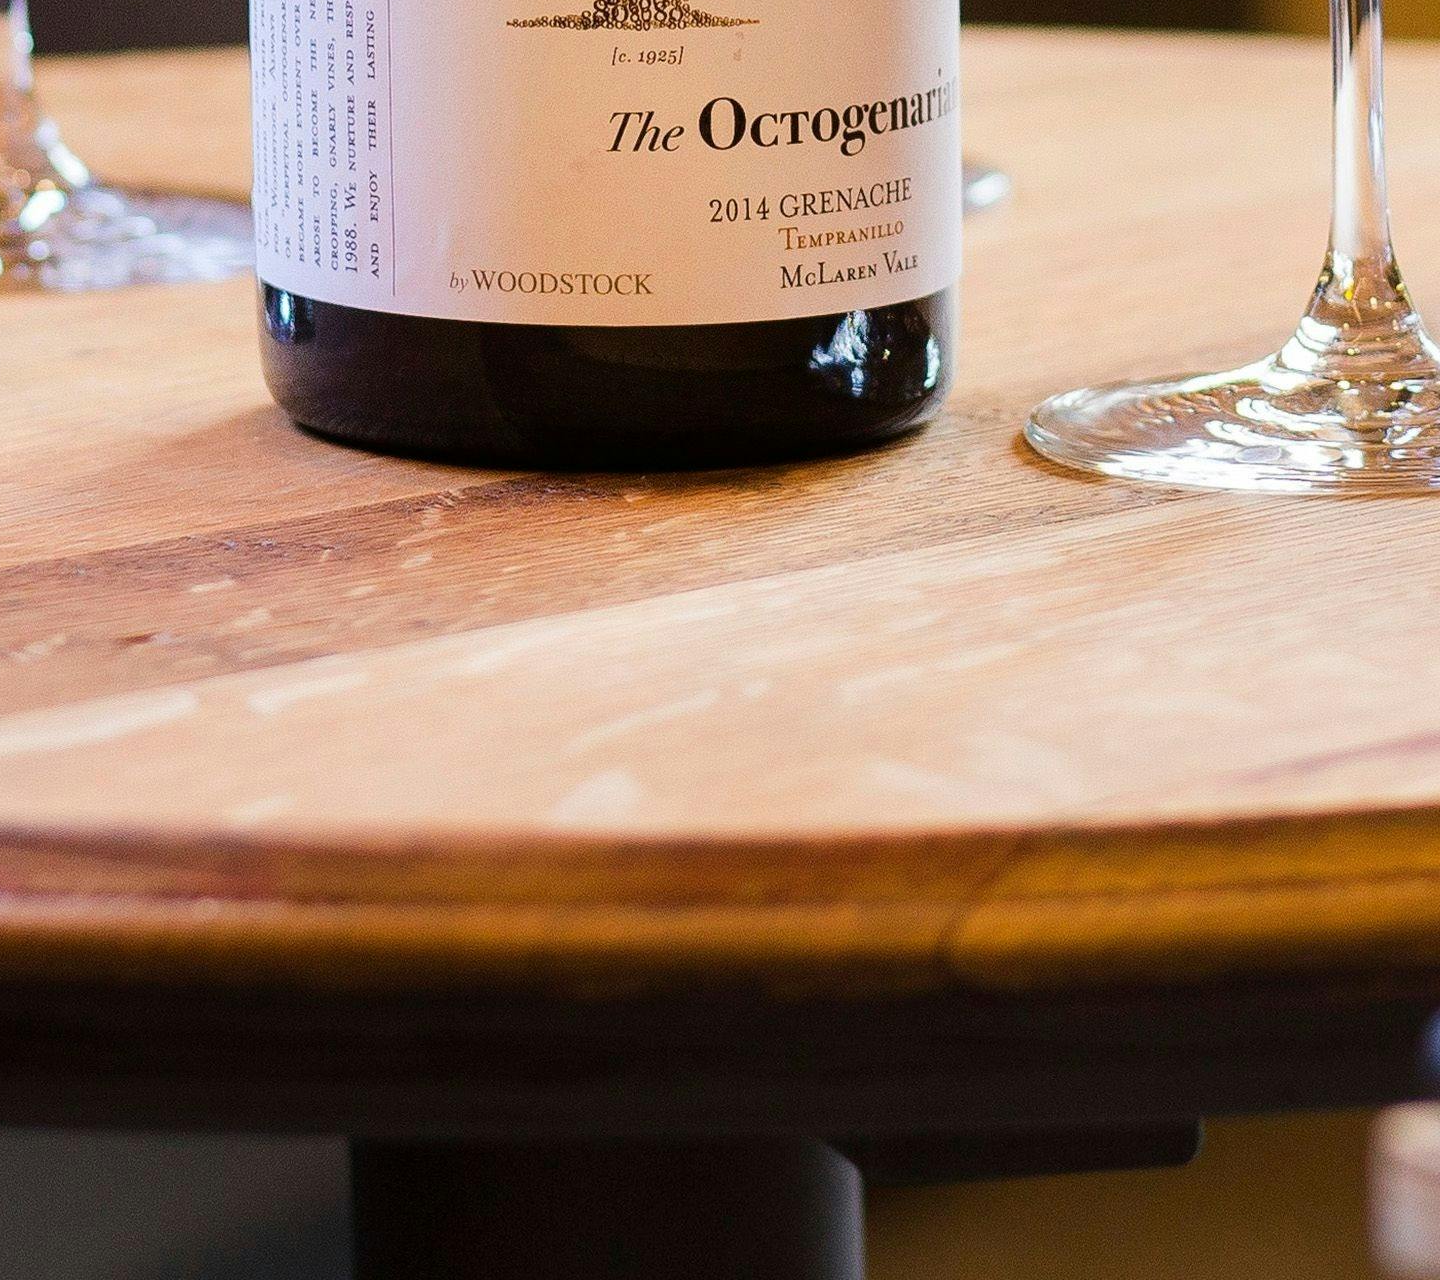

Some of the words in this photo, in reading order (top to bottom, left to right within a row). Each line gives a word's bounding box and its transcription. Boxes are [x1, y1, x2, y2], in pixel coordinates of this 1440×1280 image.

[327, 38, 336, 91] VINES,
[346, 50, 354, 86] AND
[366, 10, 375, 80] LASTING
[638, 46, 684, 65] 1925]
[311, 88, 319, 157] BECOME
[328, 104, 337, 168] GNARLY
[346, 95, 356, 172] NURTURE
[368, 100, 376, 151] THEIR
[606, 110, 685, 152] The
[312, 175, 320, 197] TO
[369, 170, 380, 222] ENJOY
[709, 196, 770, 222] 2014
[779, 177, 912, 218] GRENACHE
[285, 236, 291, 258] OR
[313, 214, 321, 268] AROSE
[330, 182, 339, 271] CROPPING,
[344, 223, 358, 273] 1988.
[370, 242, 379, 280] AND
[449, 272, 469, 293] by
[471, 269, 654, 295] WOODSTOCK
